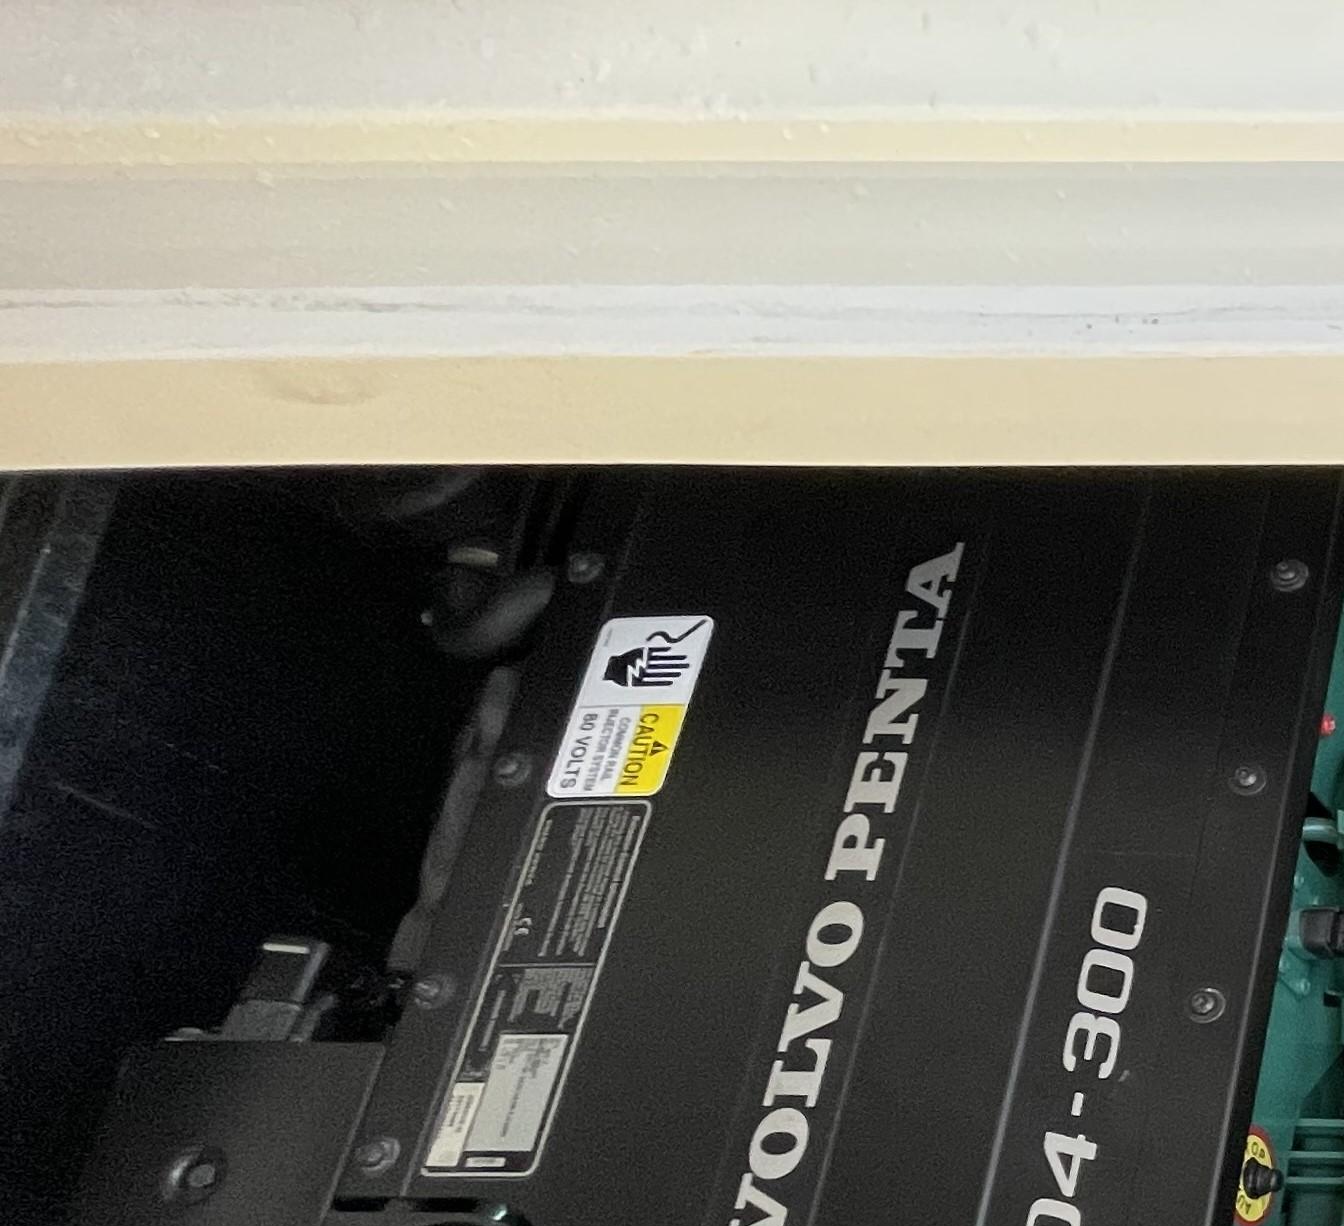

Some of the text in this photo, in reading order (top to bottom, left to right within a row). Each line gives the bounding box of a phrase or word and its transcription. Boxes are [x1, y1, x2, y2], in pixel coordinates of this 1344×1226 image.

[620, 713, 660, 786] CAUTION
[823, 542, 965, 882] PENTA
[560, 713, 599, 789] 80 VOLTS
